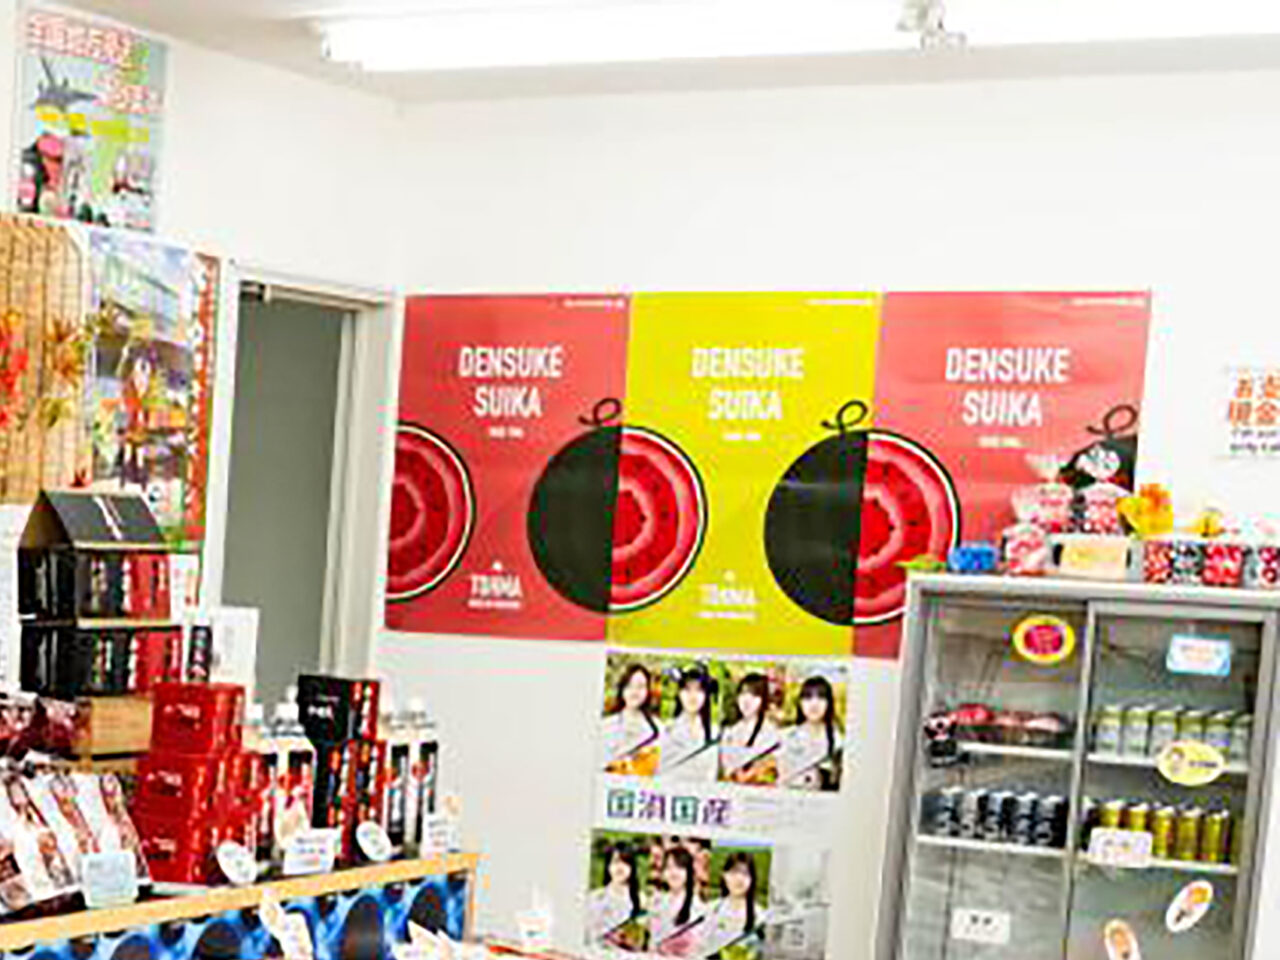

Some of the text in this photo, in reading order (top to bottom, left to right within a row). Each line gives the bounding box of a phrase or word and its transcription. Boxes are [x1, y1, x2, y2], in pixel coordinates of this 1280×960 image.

[458, 346, 564, 379] DENSUKE
[691, 348, 804, 378] DENSUKE
[945, 347, 1071, 383] DENSUKE
[473, 384, 543, 419] SUIKA
[709, 389, 783, 420] SUIKA
[961, 388, 1043, 427] SUIKA
